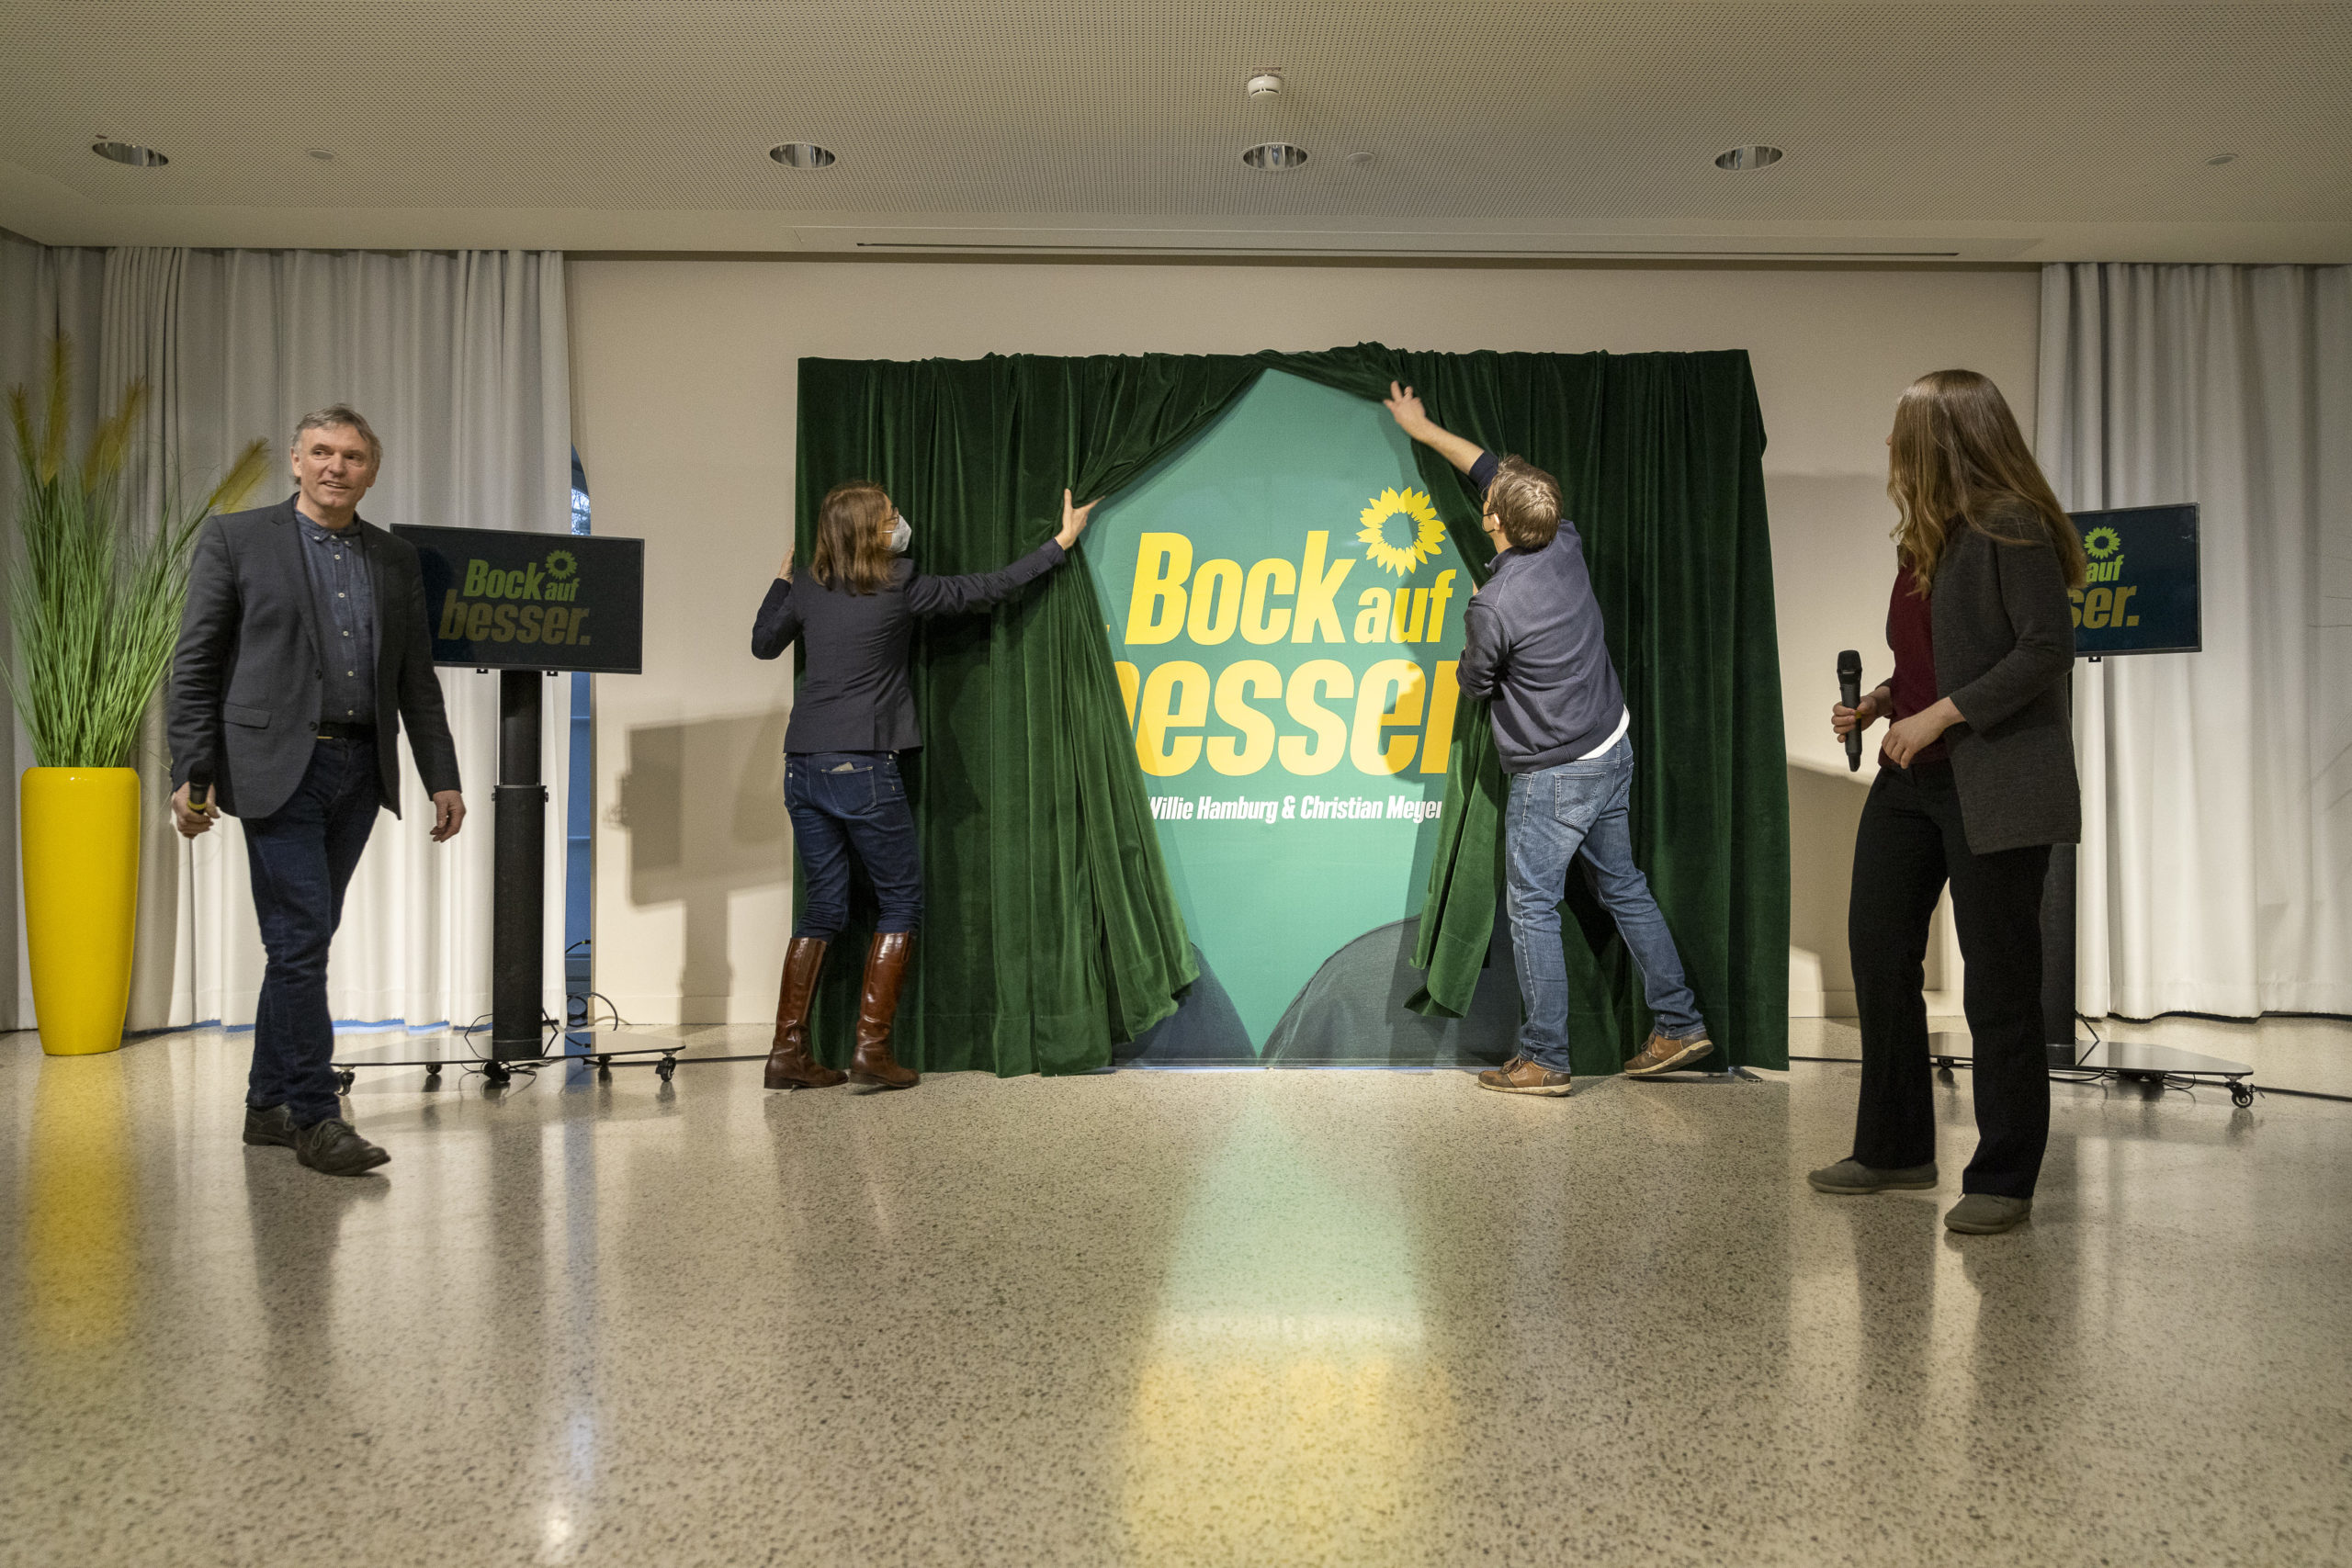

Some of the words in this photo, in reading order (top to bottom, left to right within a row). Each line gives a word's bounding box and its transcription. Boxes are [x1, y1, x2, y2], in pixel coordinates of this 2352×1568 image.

[463, 558, 546, 601] Bock
[545, 578, 580, 602] auf
[1125, 530, 1356, 645] Bock
[1354, 570, 1456, 644] auf
[2086, 555, 2124, 582] auf
[438, 589, 591, 646] besser.
[1196, 796, 1279, 824] Hamburg
[1282, 795, 1296, 819] &
[1300, 795, 1384, 819] Christian
